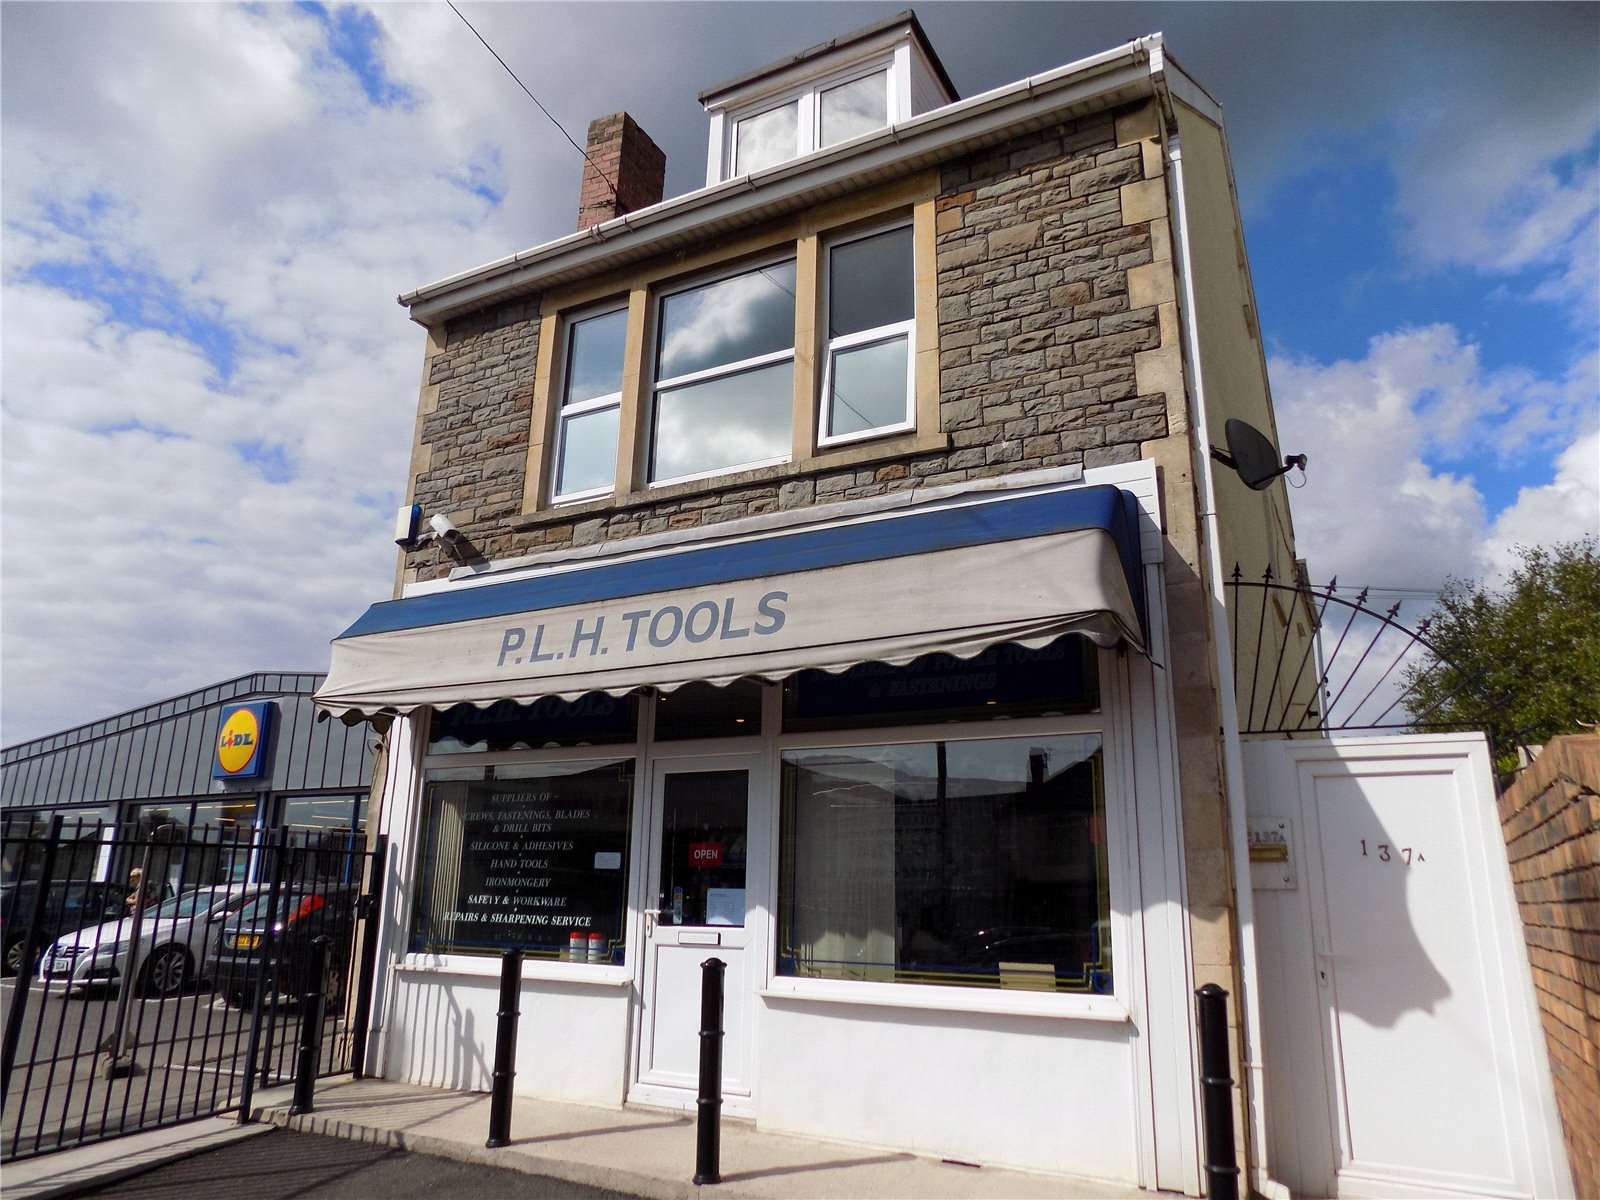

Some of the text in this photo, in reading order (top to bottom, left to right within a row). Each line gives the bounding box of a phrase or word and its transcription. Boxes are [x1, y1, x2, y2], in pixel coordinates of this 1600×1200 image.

[496, 590, 789, 667] P.L.H. TOOLS
[887, 672, 998, 697] FASTENINGS
[491, 793, 537, 803] SUPPLIERS
[539, 793, 553, 802] OF
[498, 810, 552, 821] FASTENINGS,
[555, 809, 591, 819] BLADES
[492, 823, 553, 833] & DRILL BITS
[470, 841, 575, 851] SILICONE & ADHESIVES
[693, 849, 718, 859] OPEN
[490, 859, 550, 869] HAND TOOLS
[485, 877, 552, 888] IRONMONGERY
[502, 895, 510, 905] &
[513, 896, 567, 907] WORKWARE
[443, 912, 592, 927] REPAIRS & SHARPENING SERVICE
